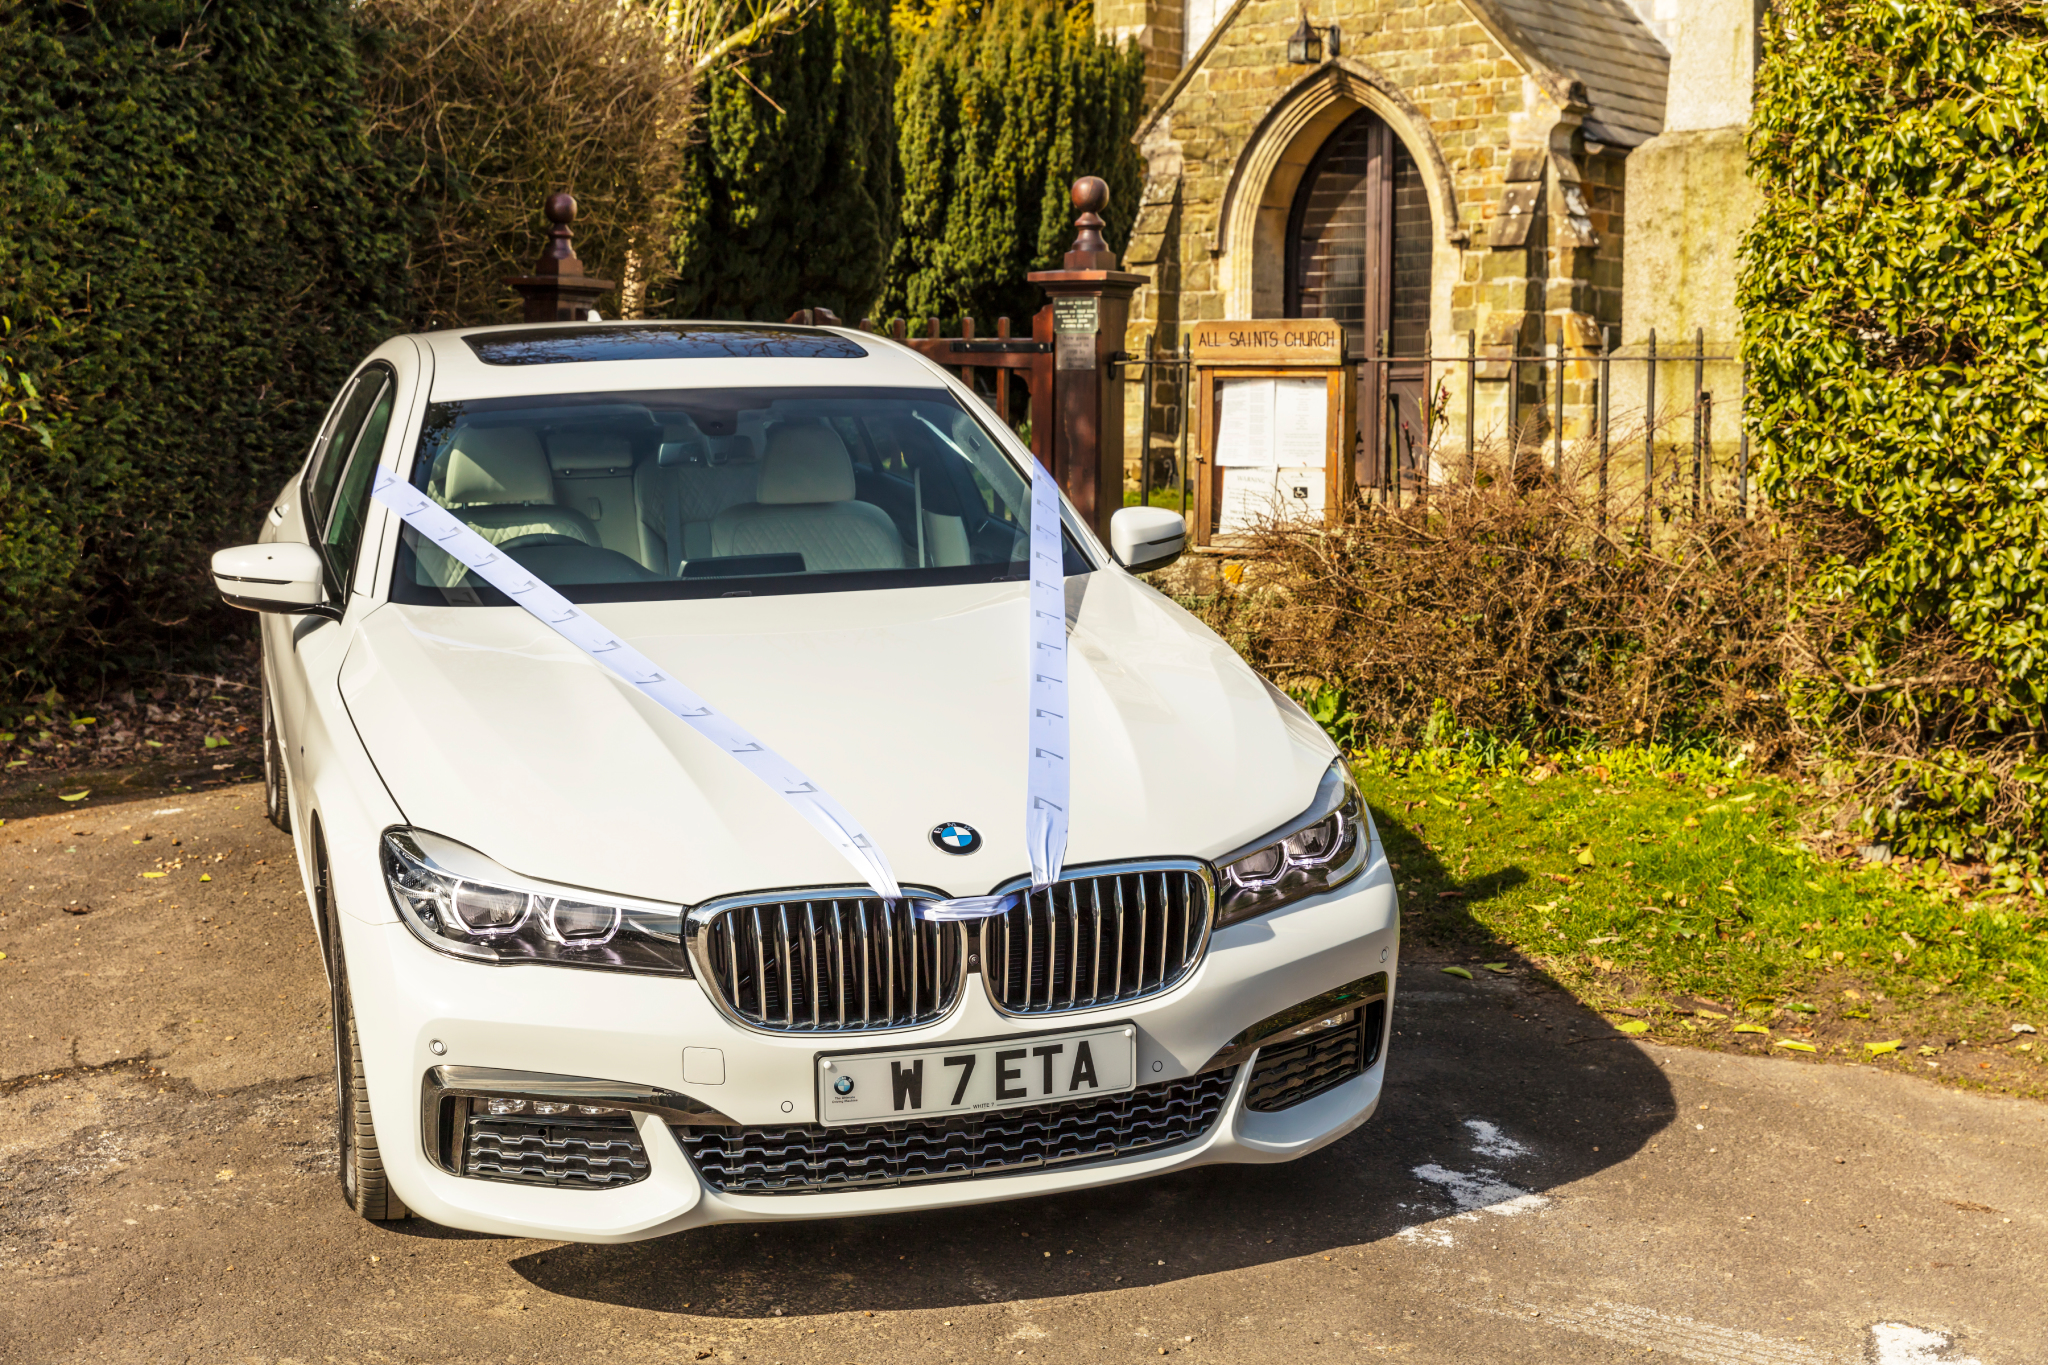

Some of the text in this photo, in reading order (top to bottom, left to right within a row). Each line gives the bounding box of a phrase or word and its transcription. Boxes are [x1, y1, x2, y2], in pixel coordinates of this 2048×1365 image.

[1199, 330, 1335, 348] ALL SAINTS CHURCH
[995, 1040, 1099, 1101] ETA
